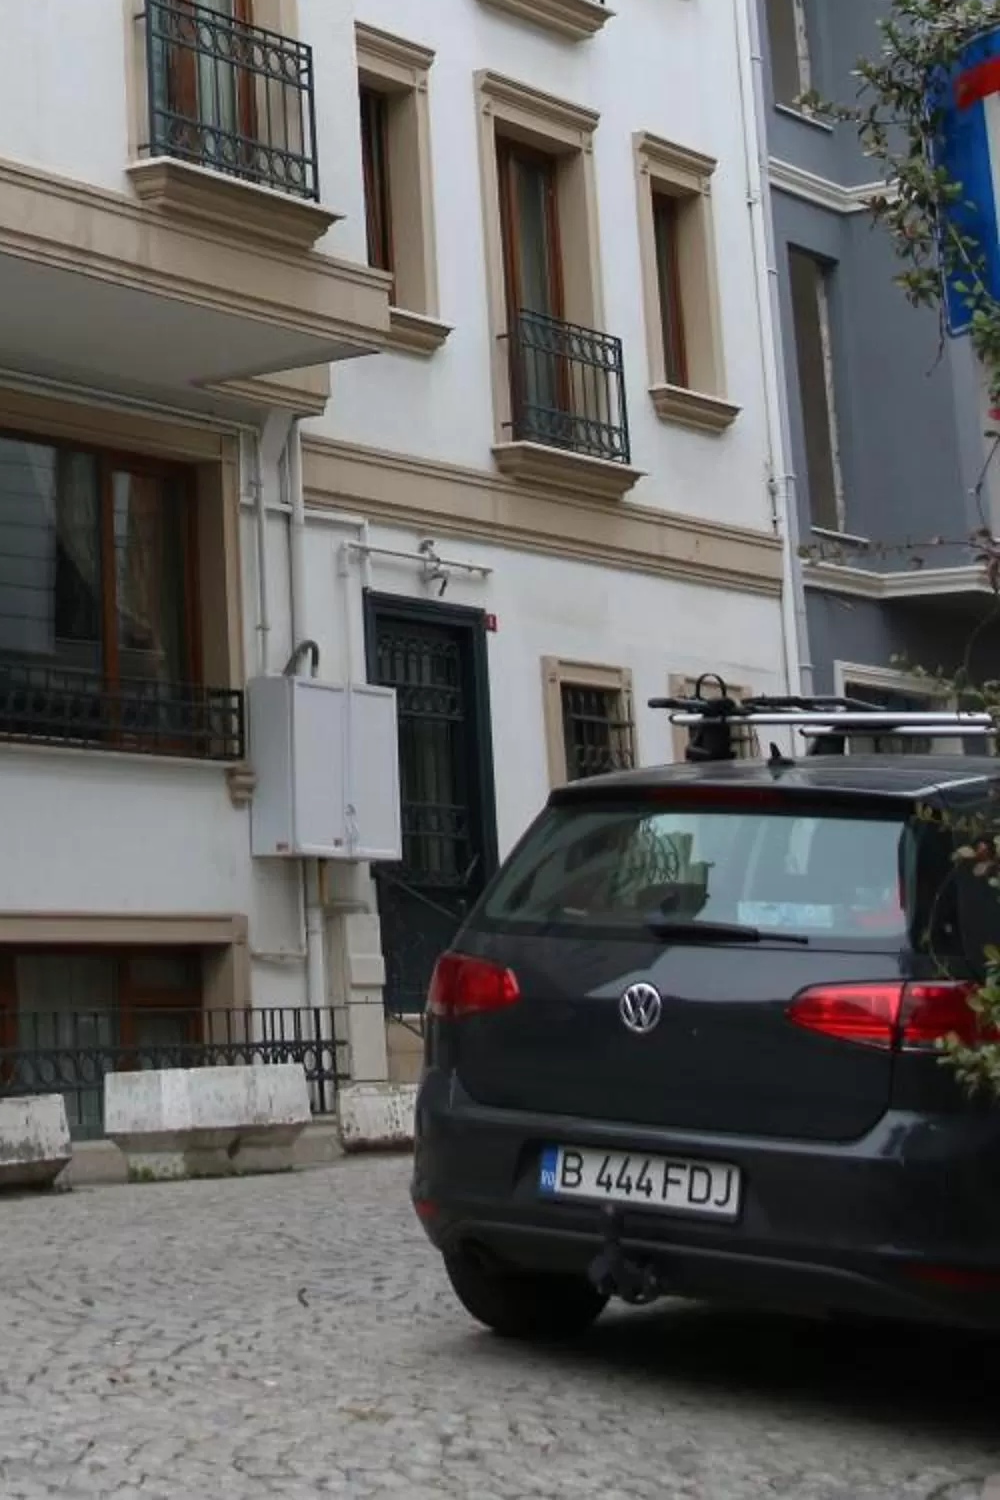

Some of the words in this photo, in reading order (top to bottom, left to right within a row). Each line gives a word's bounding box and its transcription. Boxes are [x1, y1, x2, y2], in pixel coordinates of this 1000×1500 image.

[561, 1152, 583, 1188] B
[596, 1156, 653, 1198] 444
[662, 1161, 733, 1206] FDJ
